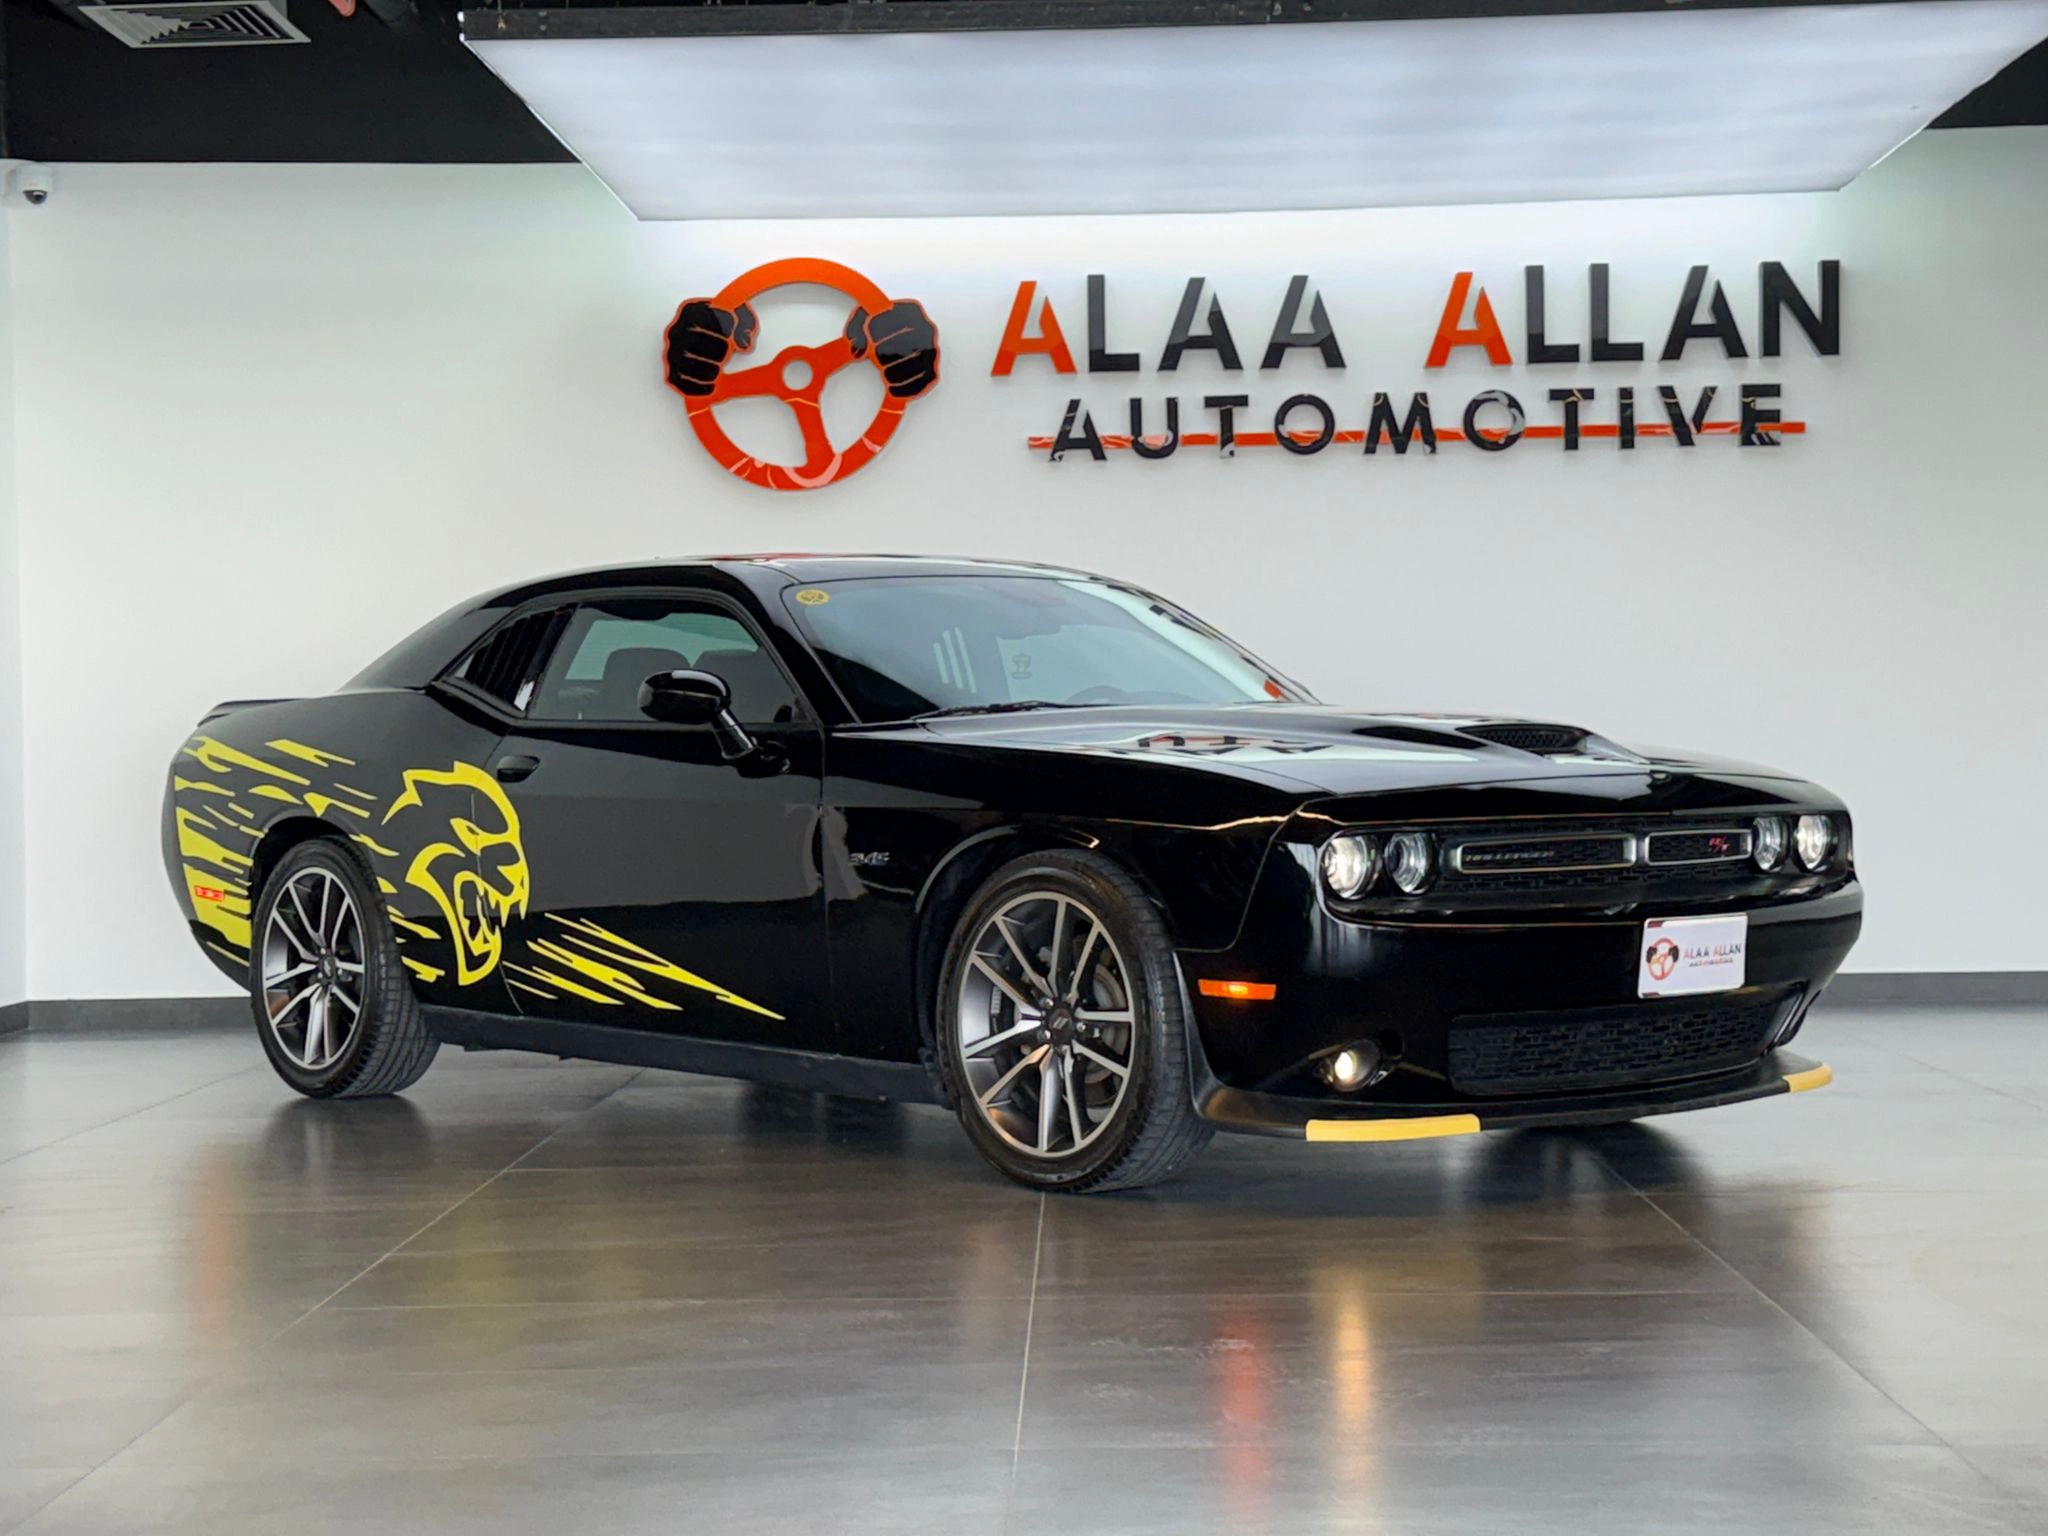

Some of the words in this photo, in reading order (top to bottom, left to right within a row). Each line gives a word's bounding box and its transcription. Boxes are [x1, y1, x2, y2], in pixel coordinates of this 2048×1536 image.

[990, 273, 1347, 377] ALAA
[1423, 259, 1841, 369] ALLAN
[1047, 383, 1783, 463] AUTOMOTIVE
